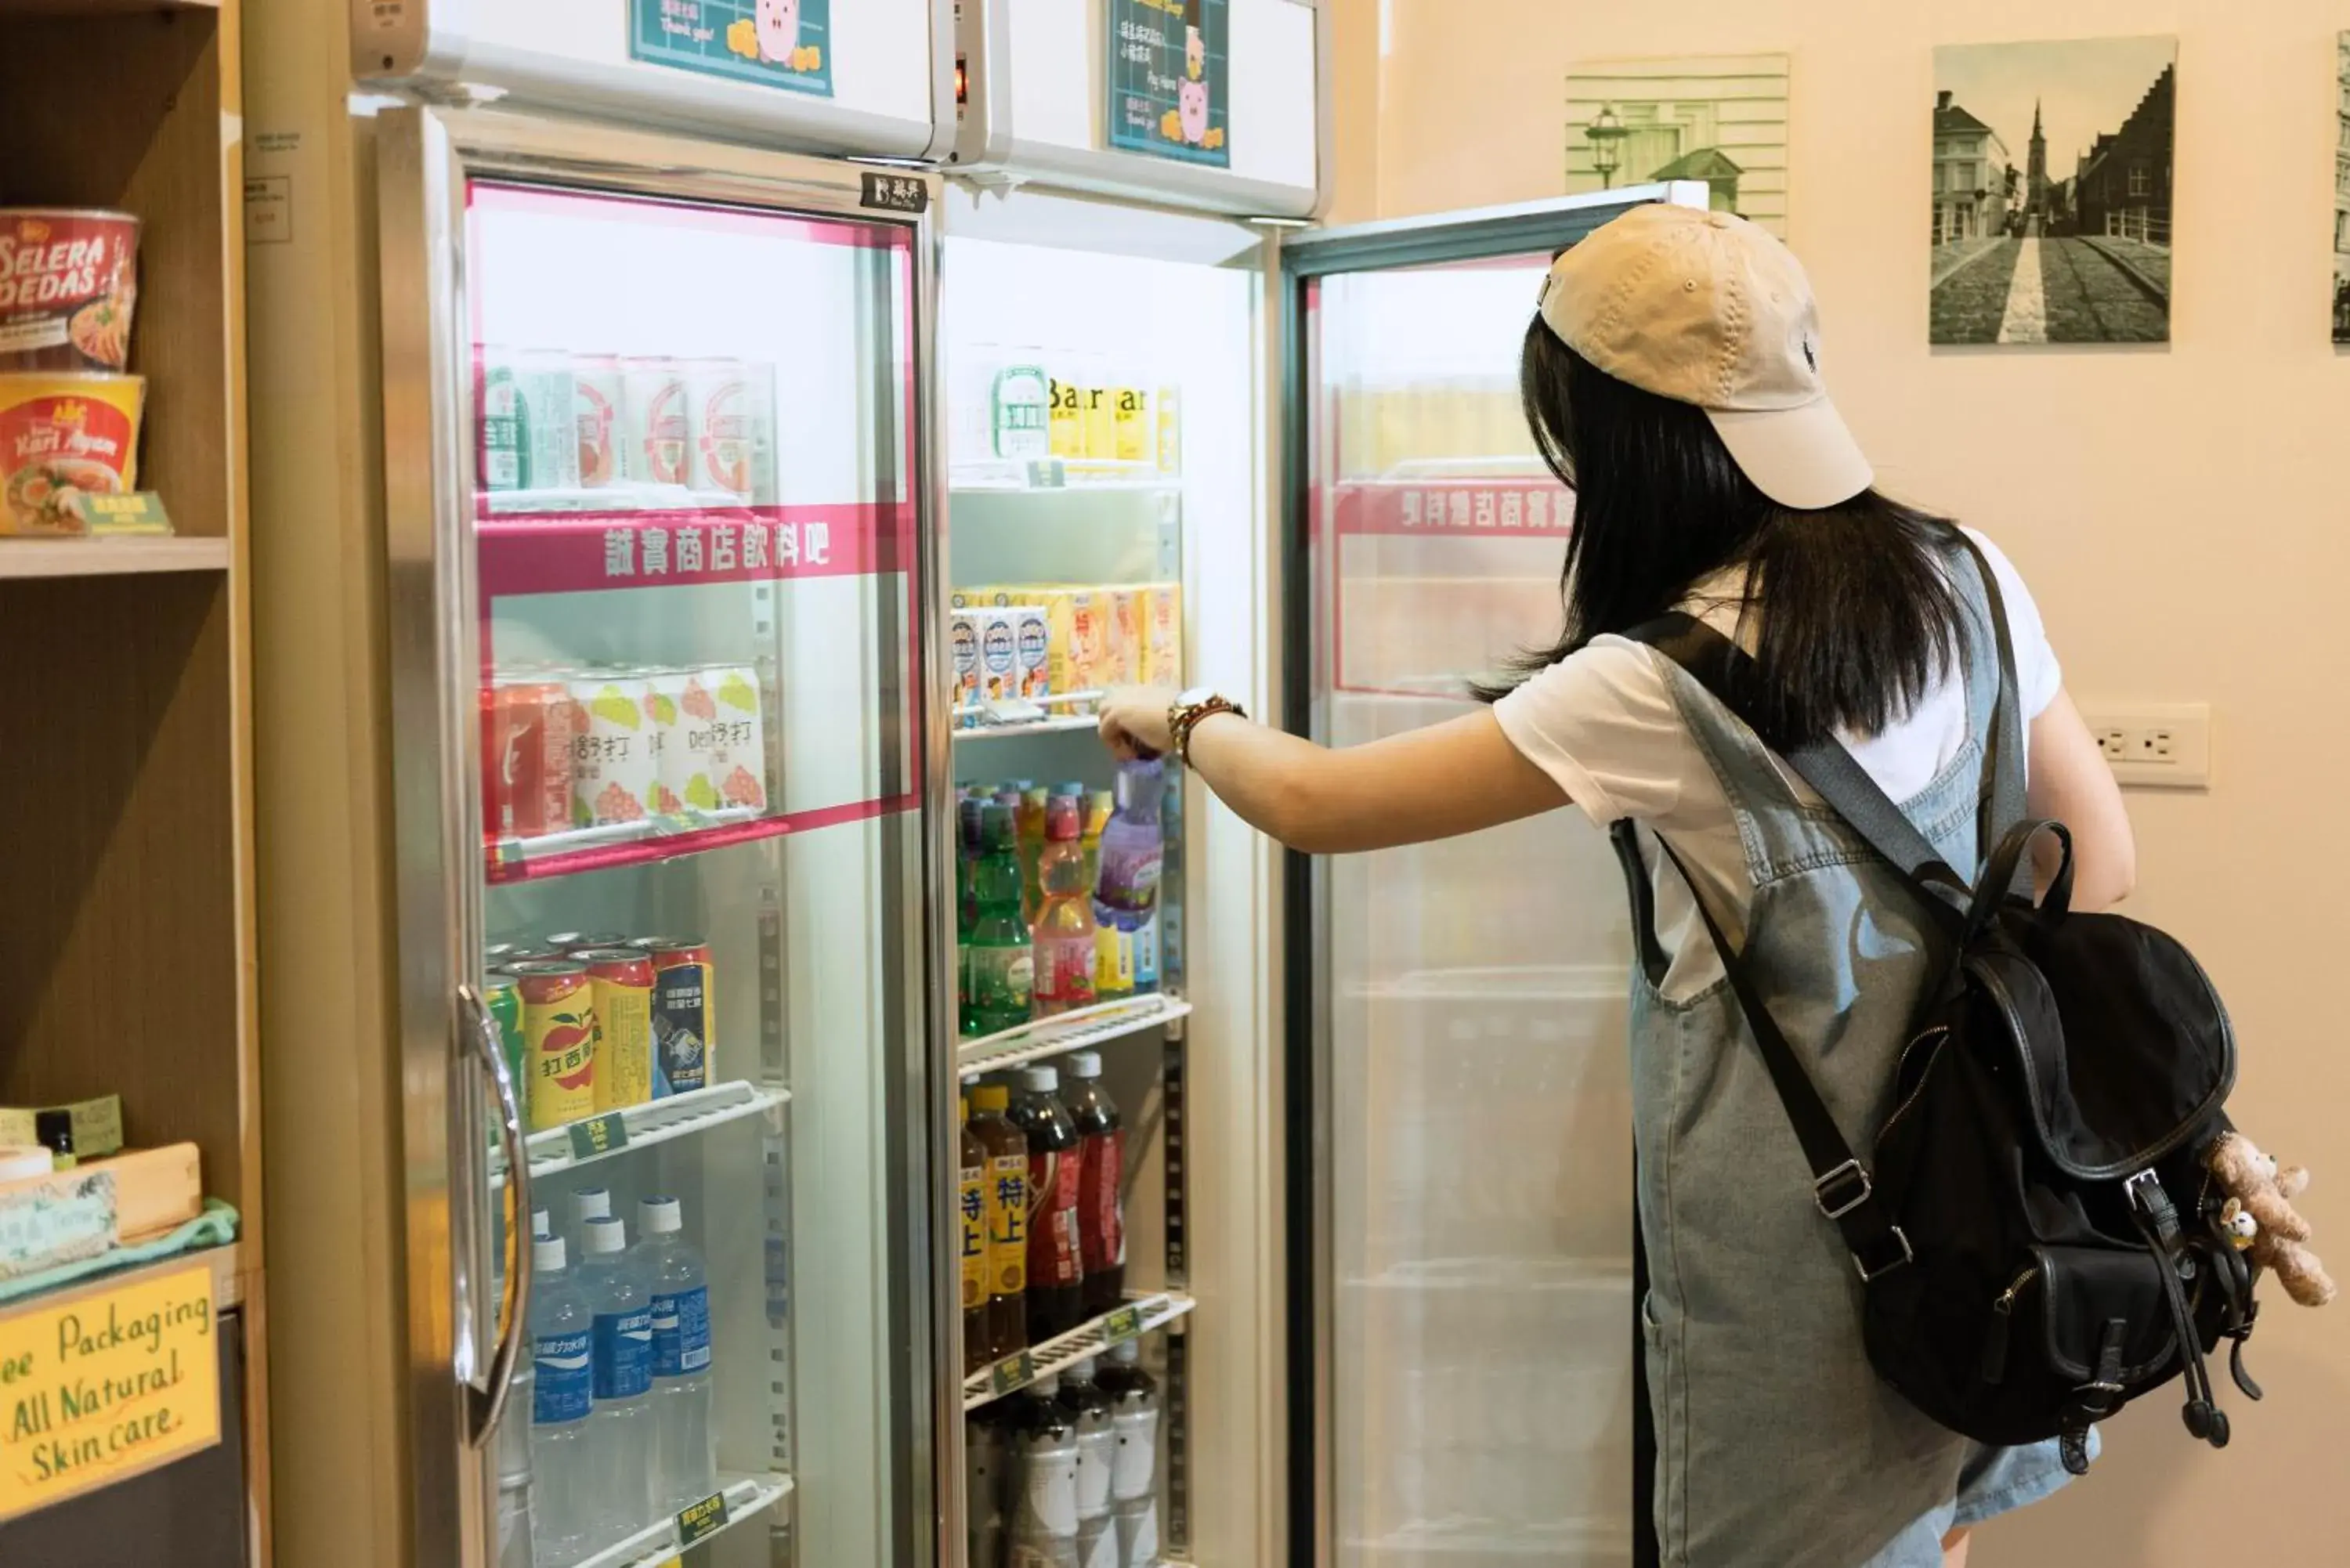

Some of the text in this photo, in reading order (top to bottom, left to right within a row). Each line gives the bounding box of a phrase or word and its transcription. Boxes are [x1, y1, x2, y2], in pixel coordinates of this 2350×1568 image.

[0, 235, 105, 280] SELERA
[57, 1297, 208, 1363] Packaging
[13, 1349, 179, 1442] All Natural
